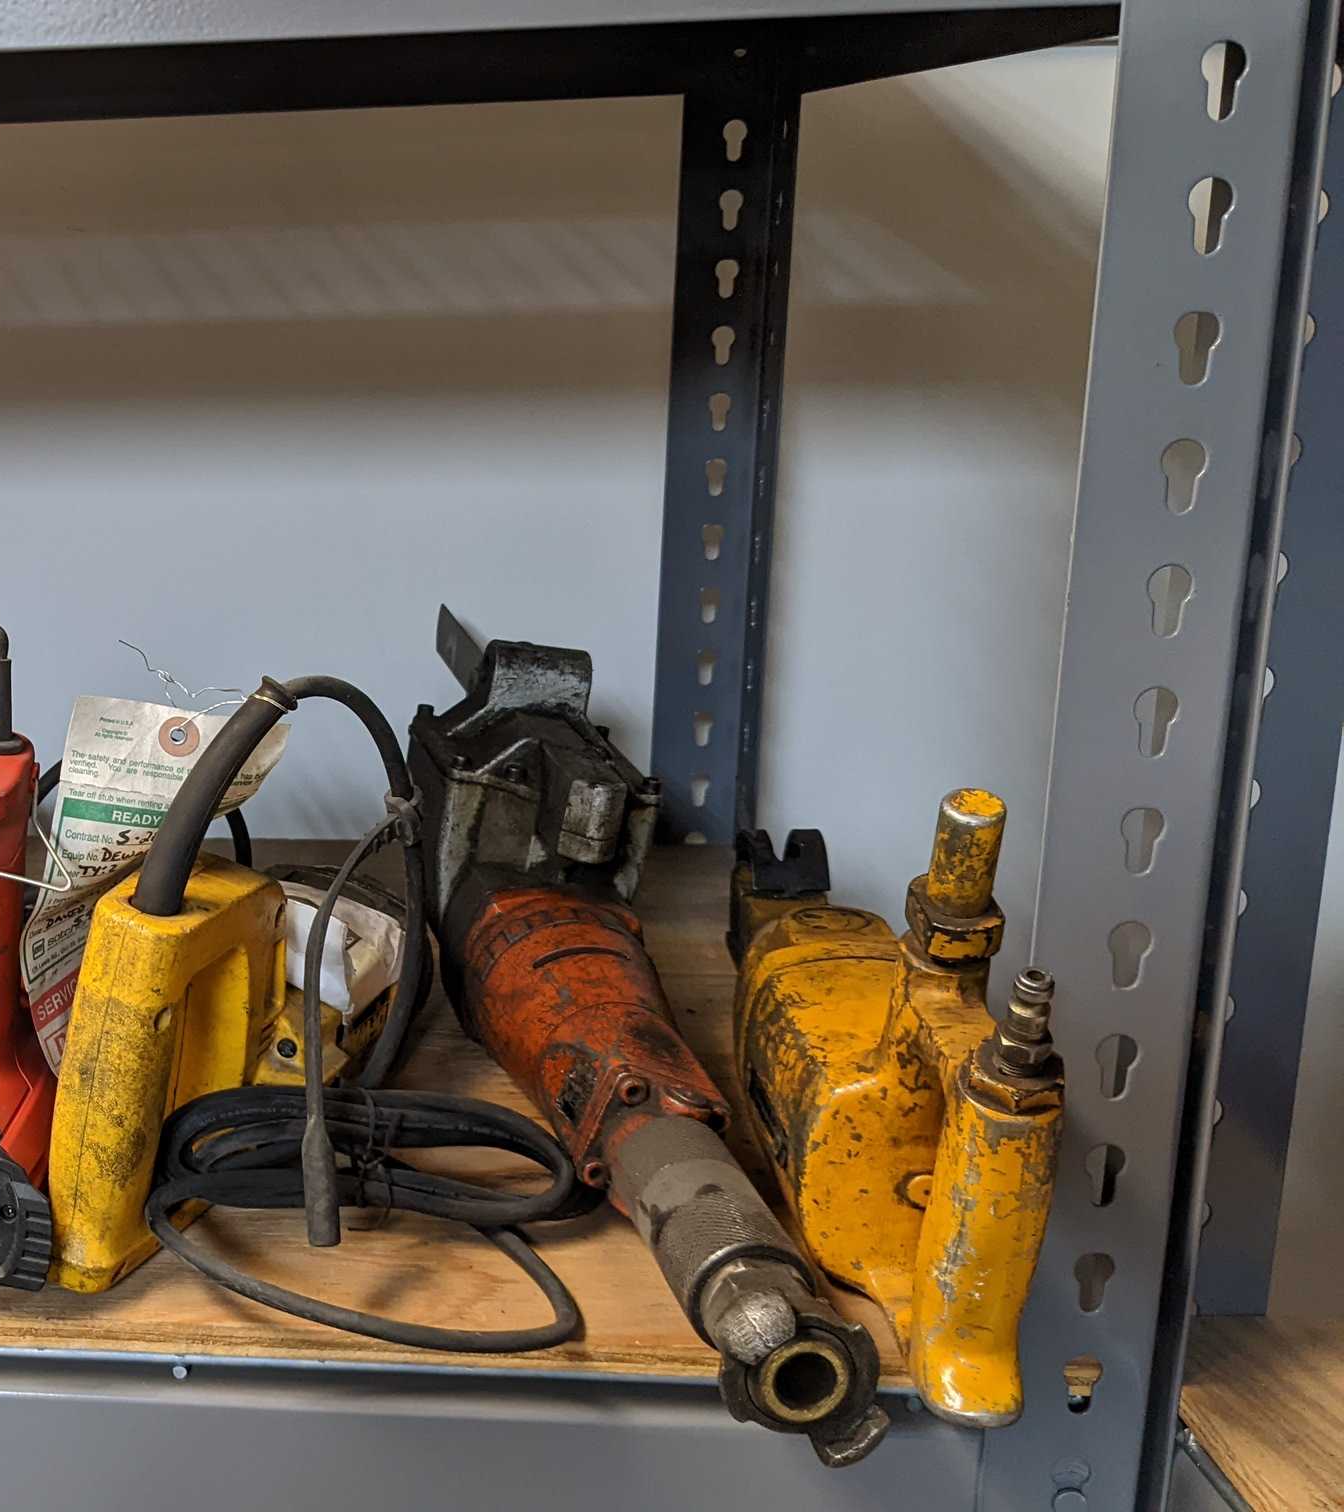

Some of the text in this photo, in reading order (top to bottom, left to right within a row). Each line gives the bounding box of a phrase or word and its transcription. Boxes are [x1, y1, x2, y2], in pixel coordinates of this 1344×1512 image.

[87, 753, 110, 764] safety
[112, 757, 127, 766] and
[128, 759, 174, 772] performance
[126, 767, 138, 775] are
[142, 768, 184, 781] responsible
[69, 787, 85, 798] Tear
[86, 791, 97, 799] off
[98, 793, 114, 802] stub
[137, 799, 163, 810] renting
[112, 810, 162, 826] READY
[65, 828, 100, 843] Contract
[101, 834, 114, 844] No.
[61, 848, 85, 861] Equip
[86, 850, 98, 861] No.
[36, 977, 77, 1021] SERVIC
